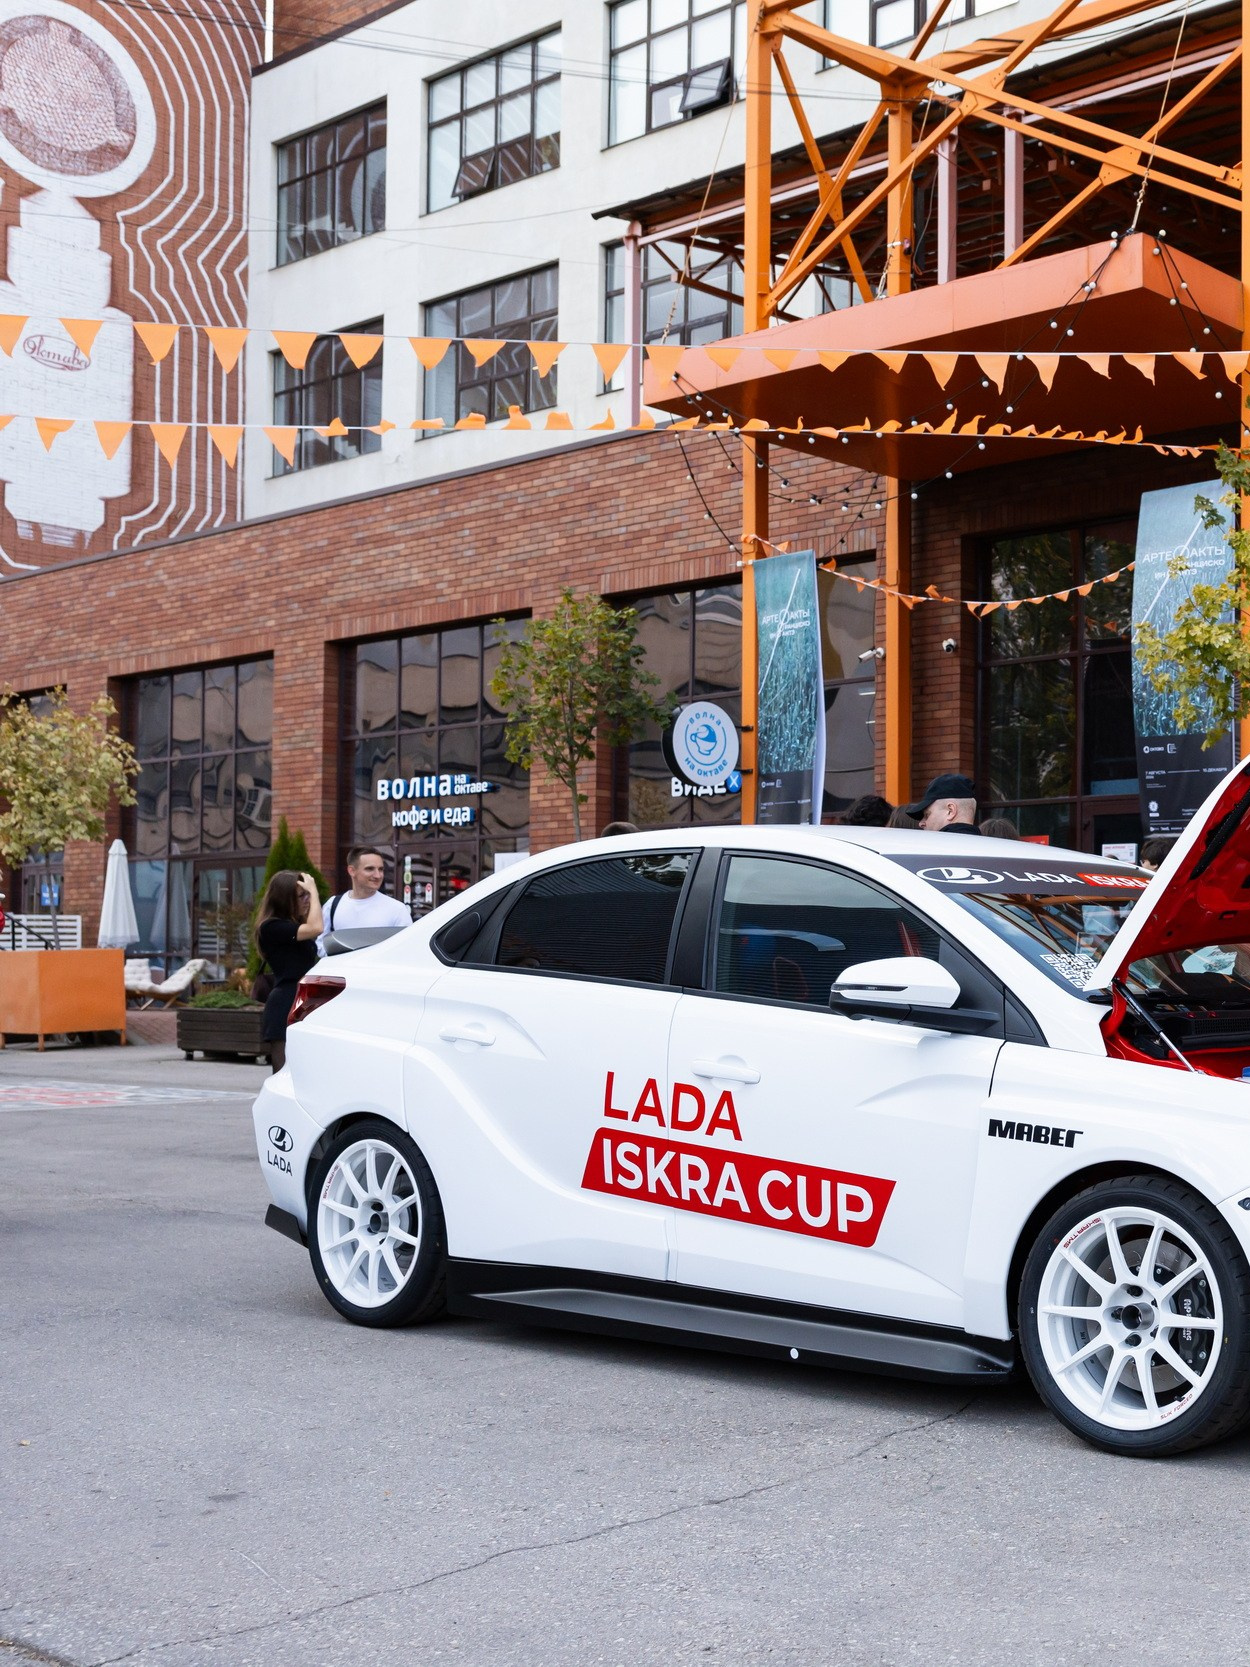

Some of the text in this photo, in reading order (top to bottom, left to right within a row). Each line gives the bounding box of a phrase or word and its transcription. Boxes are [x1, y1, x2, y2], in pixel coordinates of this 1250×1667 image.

[454, 774, 467, 784] на
[454, 781, 488, 795] октаве
[392, 805, 471, 830] кофе и еда
[1003, 871, 1085, 885] LADA
[603, 1071, 743, 1142] LADA
[267, 1150, 293, 1176] LADA
[603, 1138, 874, 1233] ISKRA CUP
